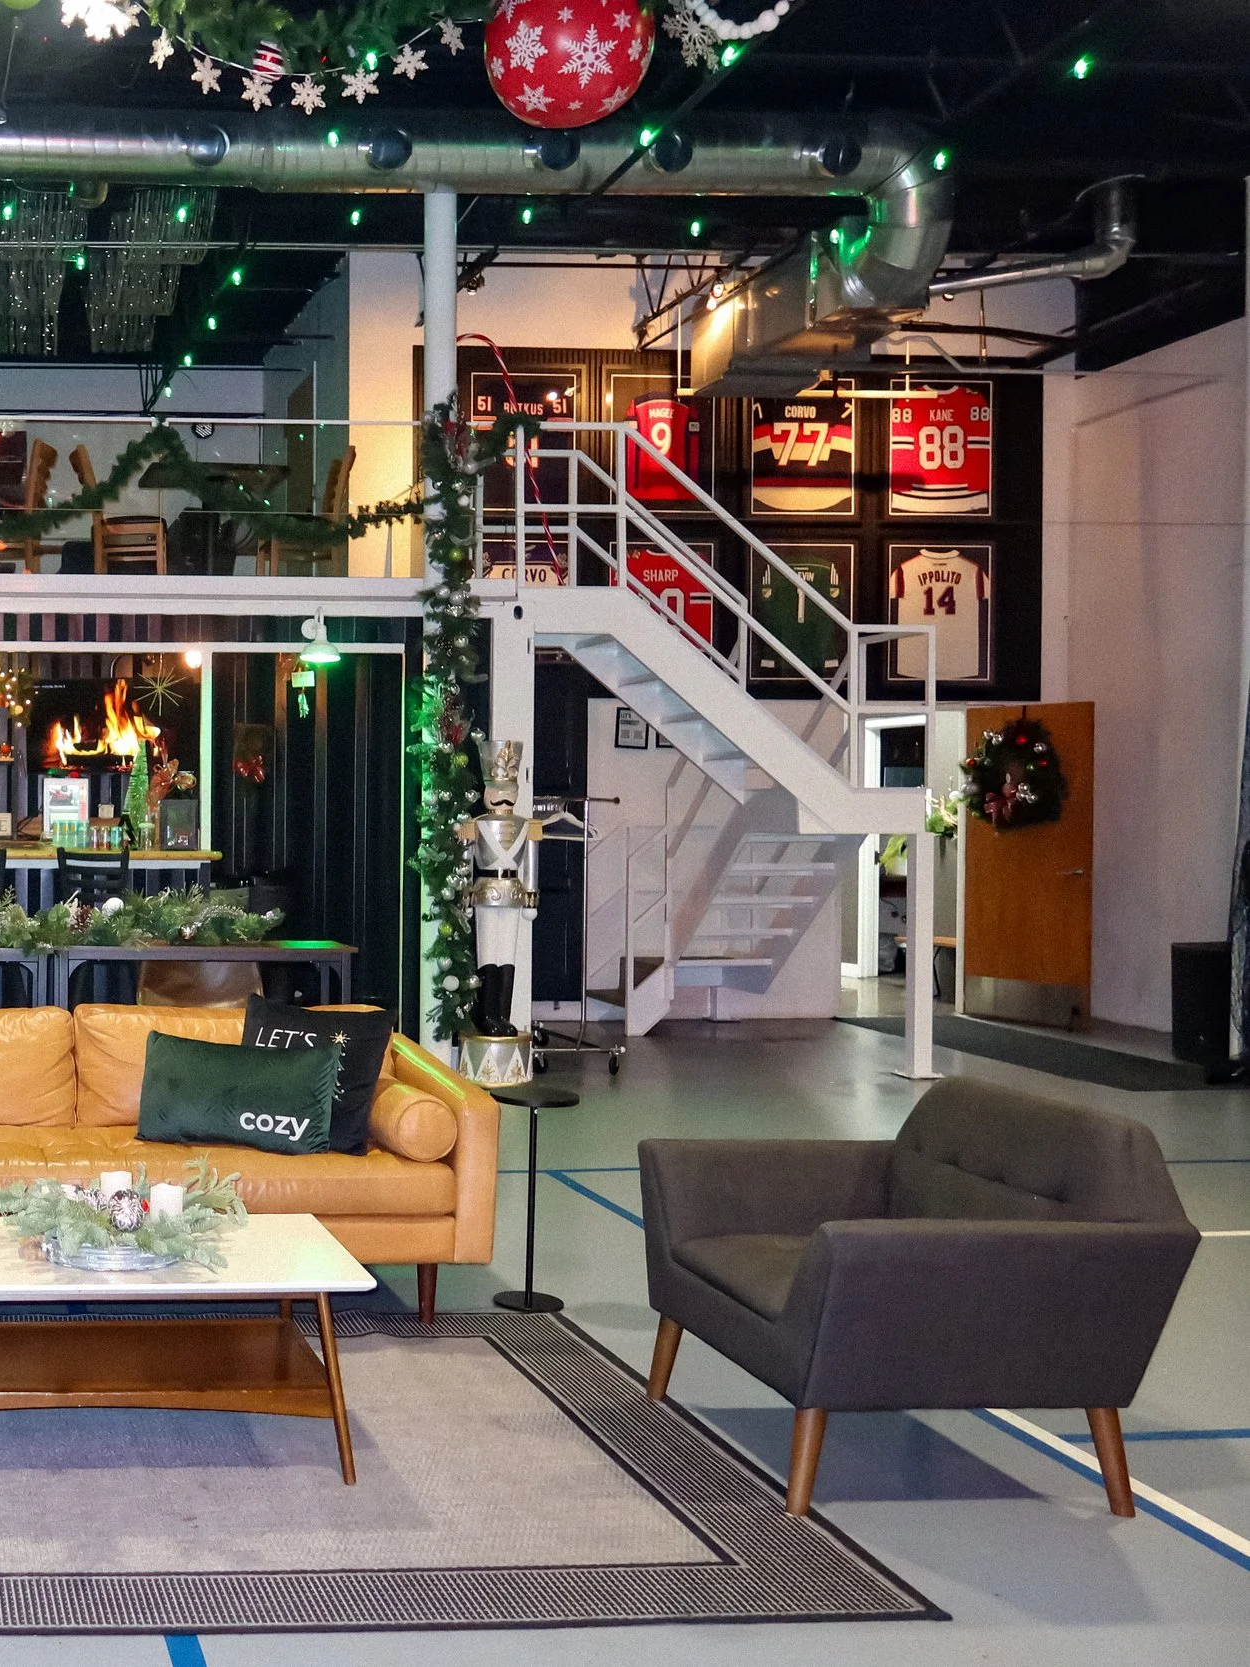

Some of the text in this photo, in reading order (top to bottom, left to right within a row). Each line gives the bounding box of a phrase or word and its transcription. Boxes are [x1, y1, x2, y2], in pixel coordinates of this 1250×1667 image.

[477, 396, 492, 412] 51
[552, 398, 567, 414] 51
[784, 405, 817, 419] CORVO
[891, 407, 912, 423] 88
[929, 408, 954, 422] KANE
[970, 406, 990, 421] 88
[651, 421, 672, 456] 9
[773, 422, 829, 467] 77
[918, 425, 965, 470] 88
[502, 568, 547, 583] CVO
[642, 569, 679, 582] SHARP
[797, 571, 815, 582] EVIN
[918, 570, 962, 586] IPPOLITO
[923, 586, 956, 615] 14
[255, 1026, 318, 1049] LET'S
[239, 1111, 310, 1142] cozy
